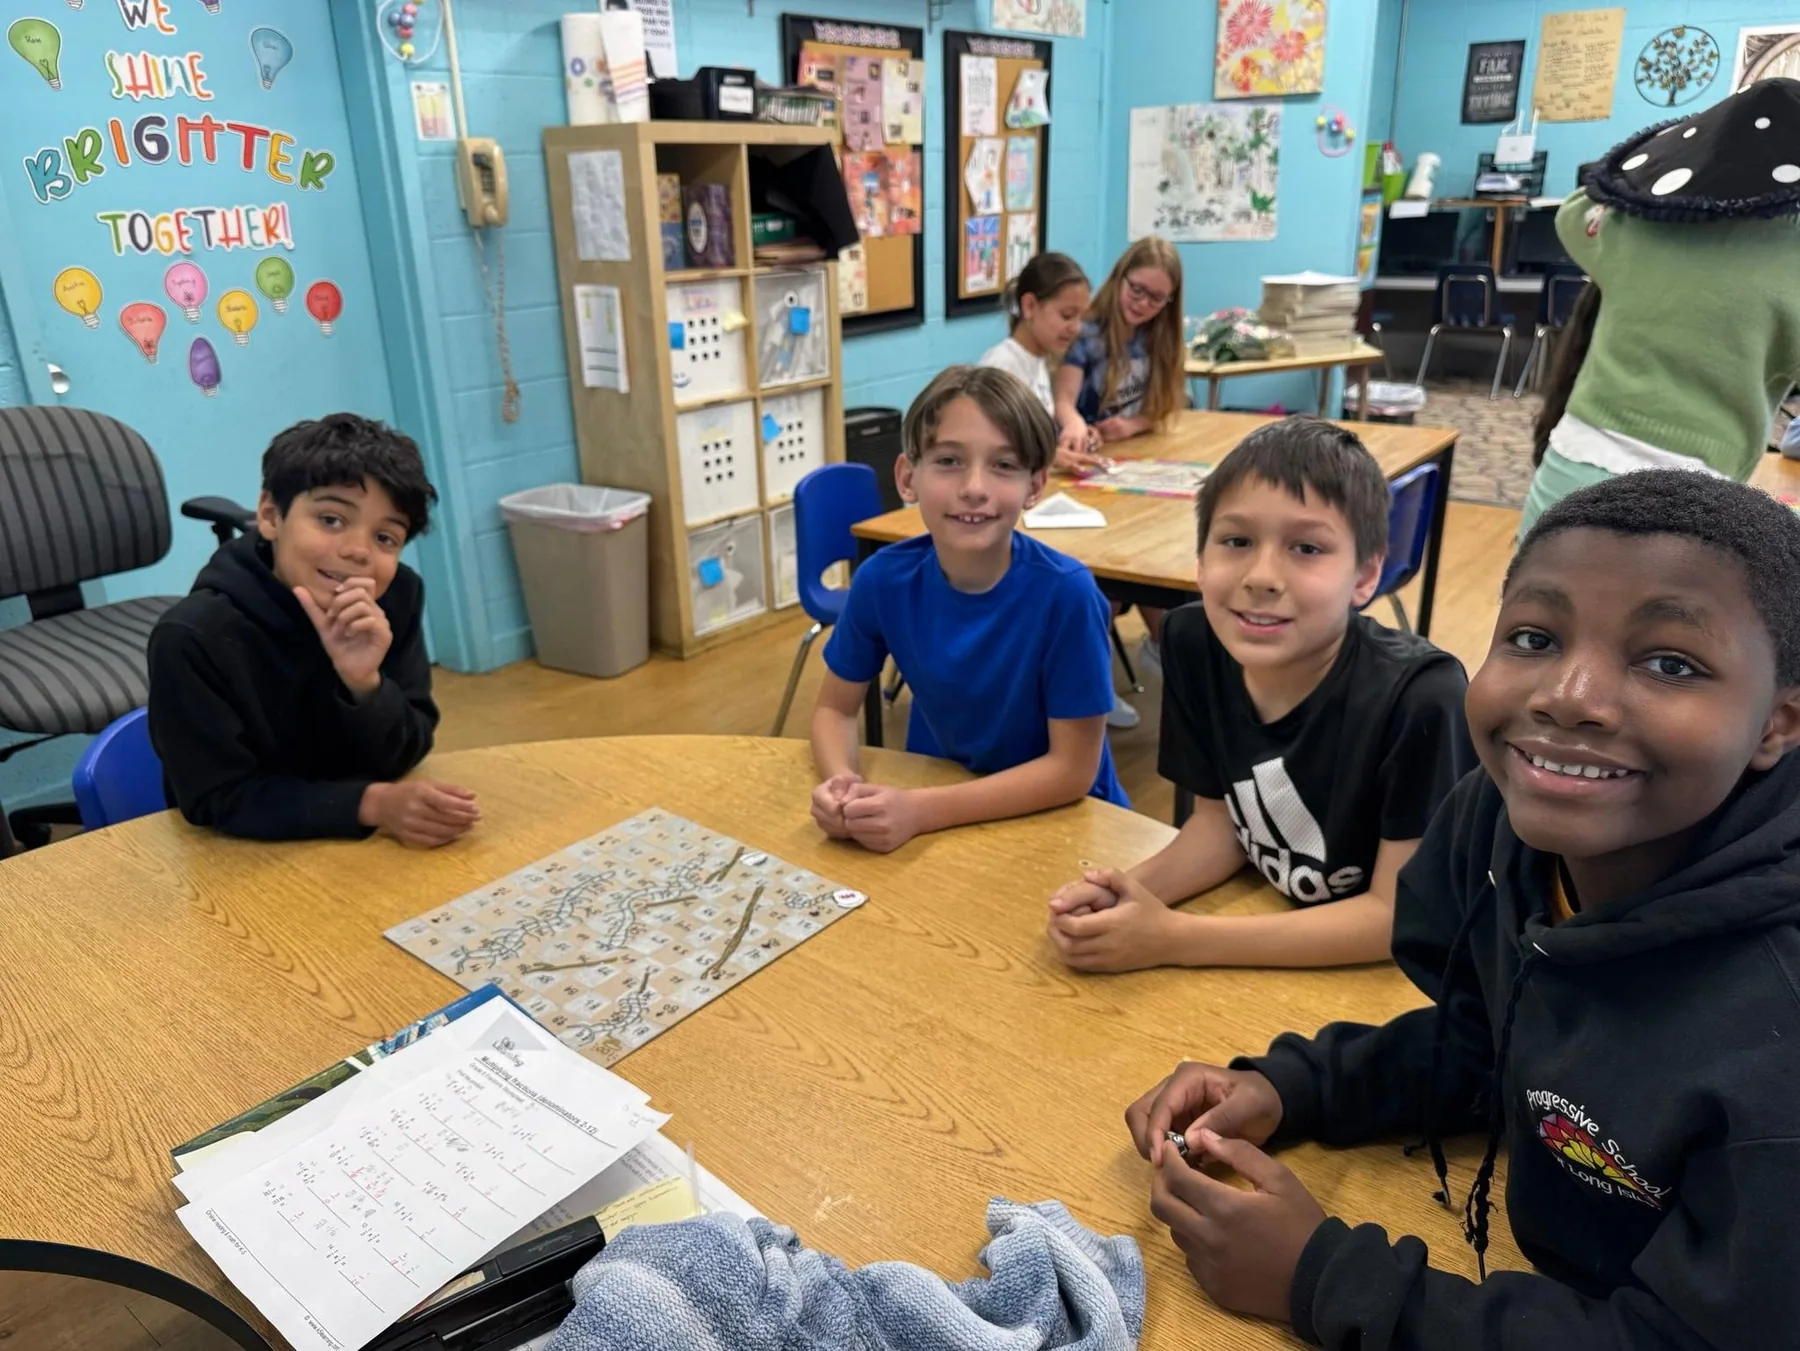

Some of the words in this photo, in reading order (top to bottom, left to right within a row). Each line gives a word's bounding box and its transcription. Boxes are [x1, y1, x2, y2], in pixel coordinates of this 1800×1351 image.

[119, 0, 175, 32] WE
[107, 52, 212, 98] SHINE
[26, 116, 334, 201] BRIGHTER
[99, 204, 292, 253] TOGETHER!
[1233, 827, 1363, 903] didas
[482, 1056, 512, 1081] Multiplying
[511, 1074, 538, 1098] fractions
[1526, 1089, 1599, 1137] Progressive
[1601, 1139, 1672, 1199] School
[1568, 1162, 1613, 1194] Long
